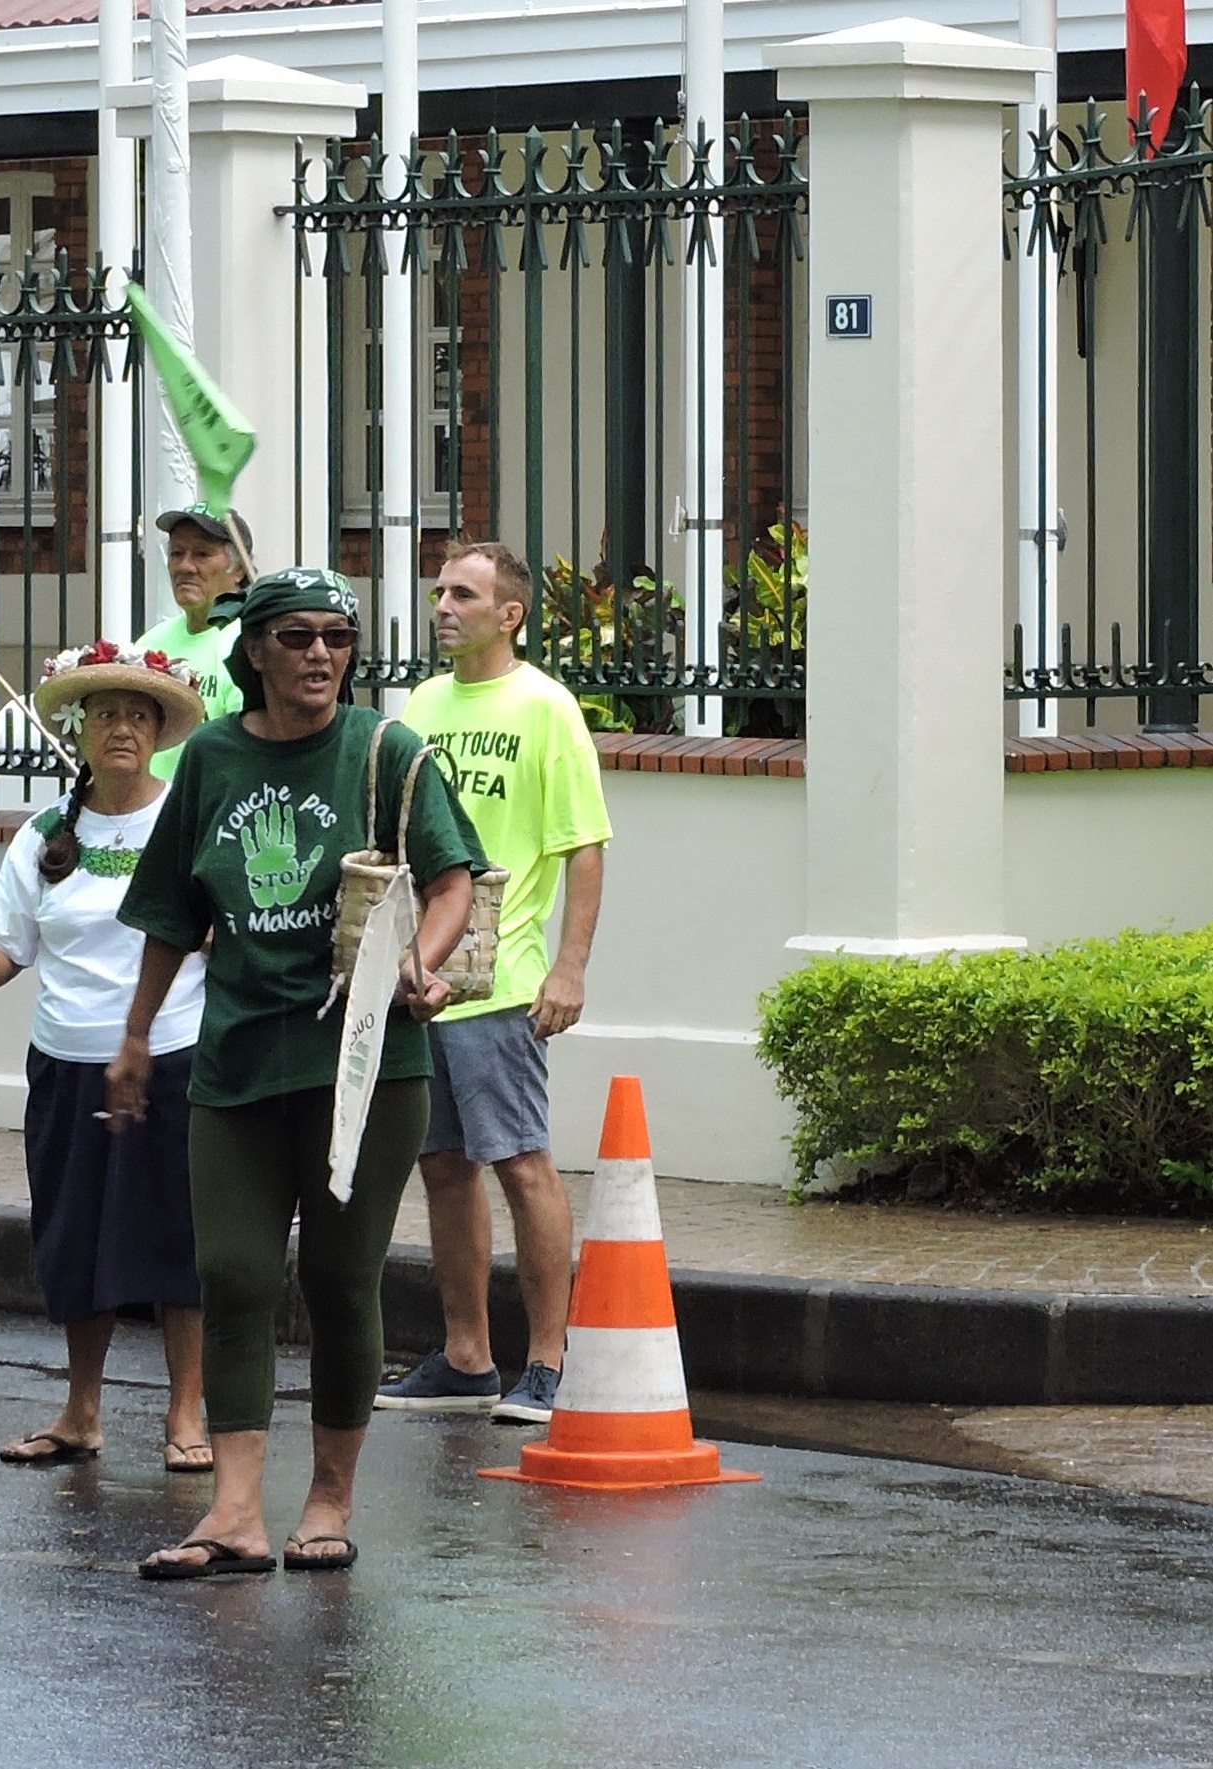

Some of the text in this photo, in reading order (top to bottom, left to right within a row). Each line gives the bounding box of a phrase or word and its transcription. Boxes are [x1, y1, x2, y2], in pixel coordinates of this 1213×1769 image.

[835, 302, 857, 330] 81
[460, 730, 521, 763] TOUCH
[216, 783, 337, 846] Touche pas
[250, 868, 308, 889] STOP
